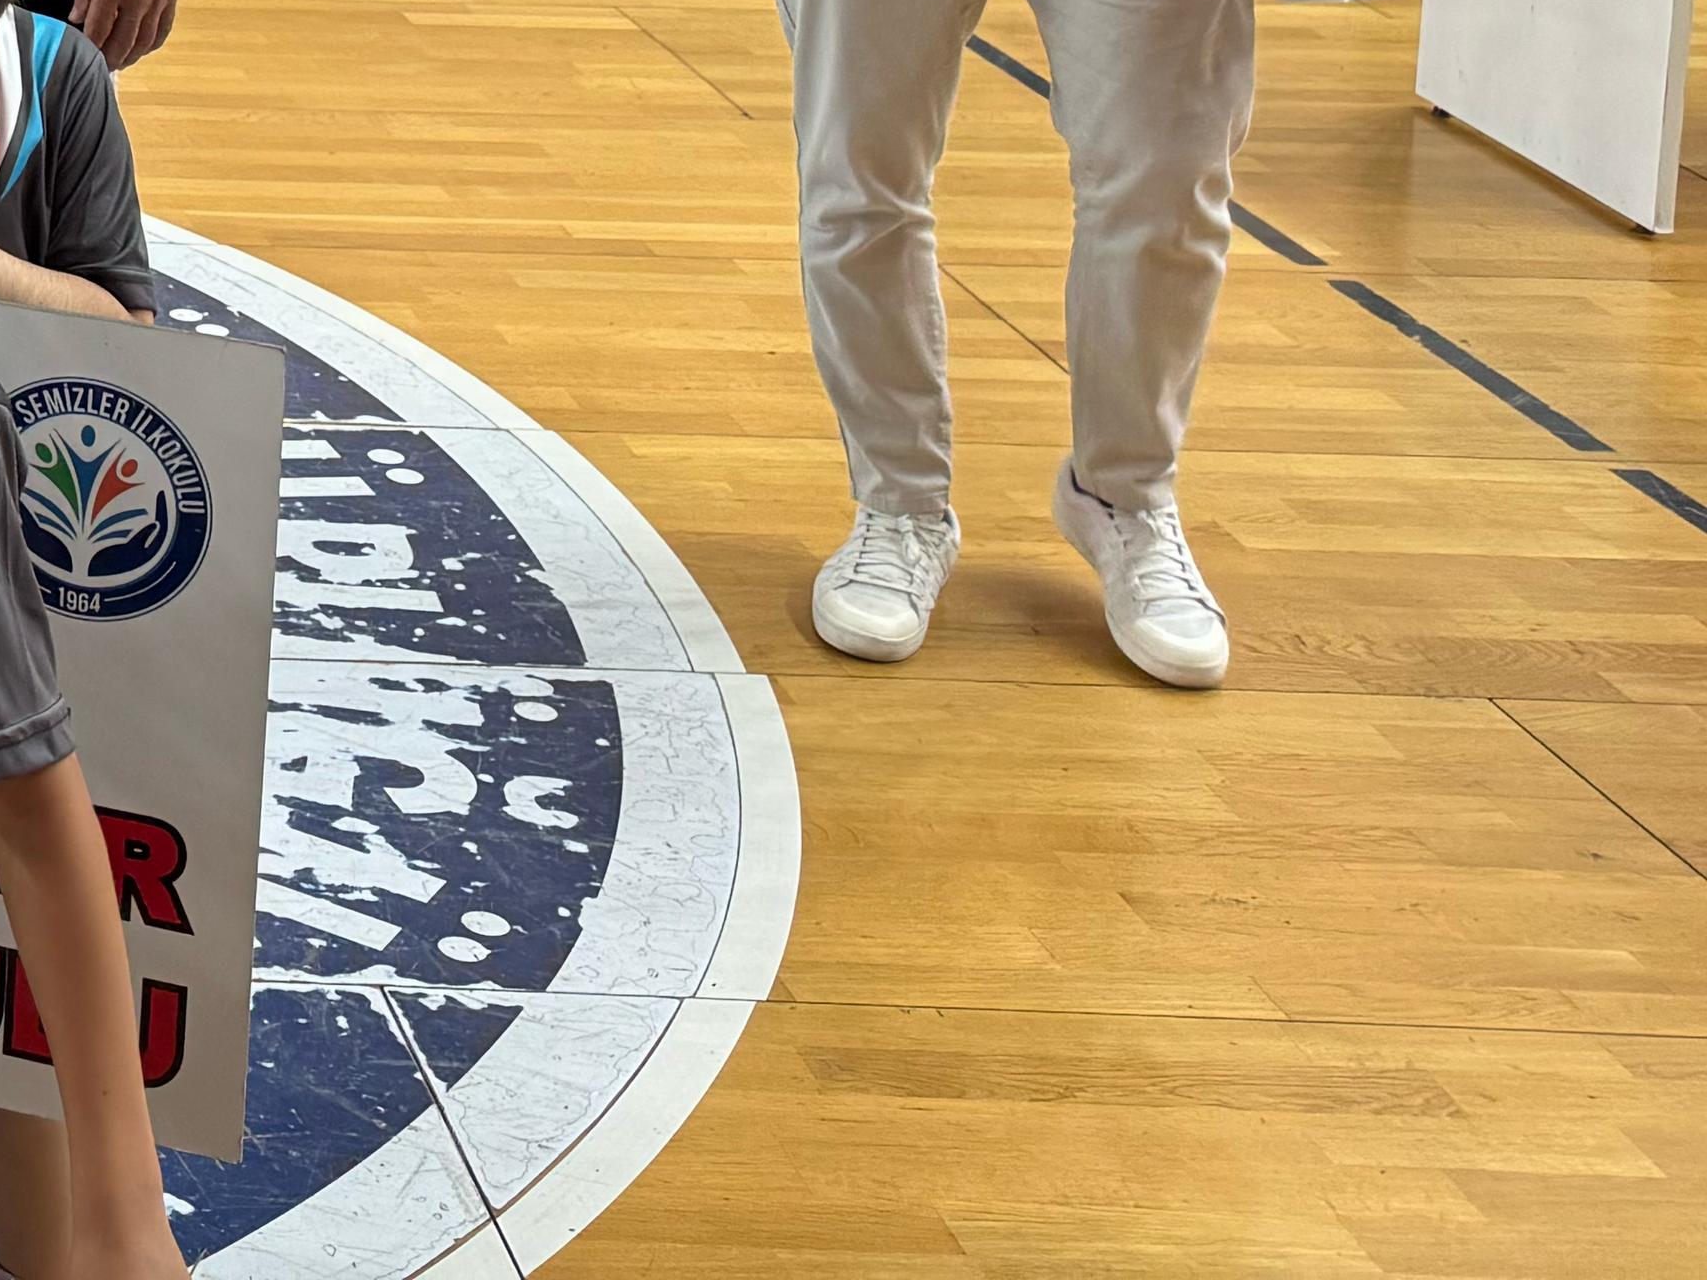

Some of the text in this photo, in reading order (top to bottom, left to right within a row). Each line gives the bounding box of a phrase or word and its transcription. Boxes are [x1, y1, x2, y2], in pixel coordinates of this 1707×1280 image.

[14, 382, 206, 515] SEMİZLER İLKOKULU
[57, 586, 101, 613] 1964
